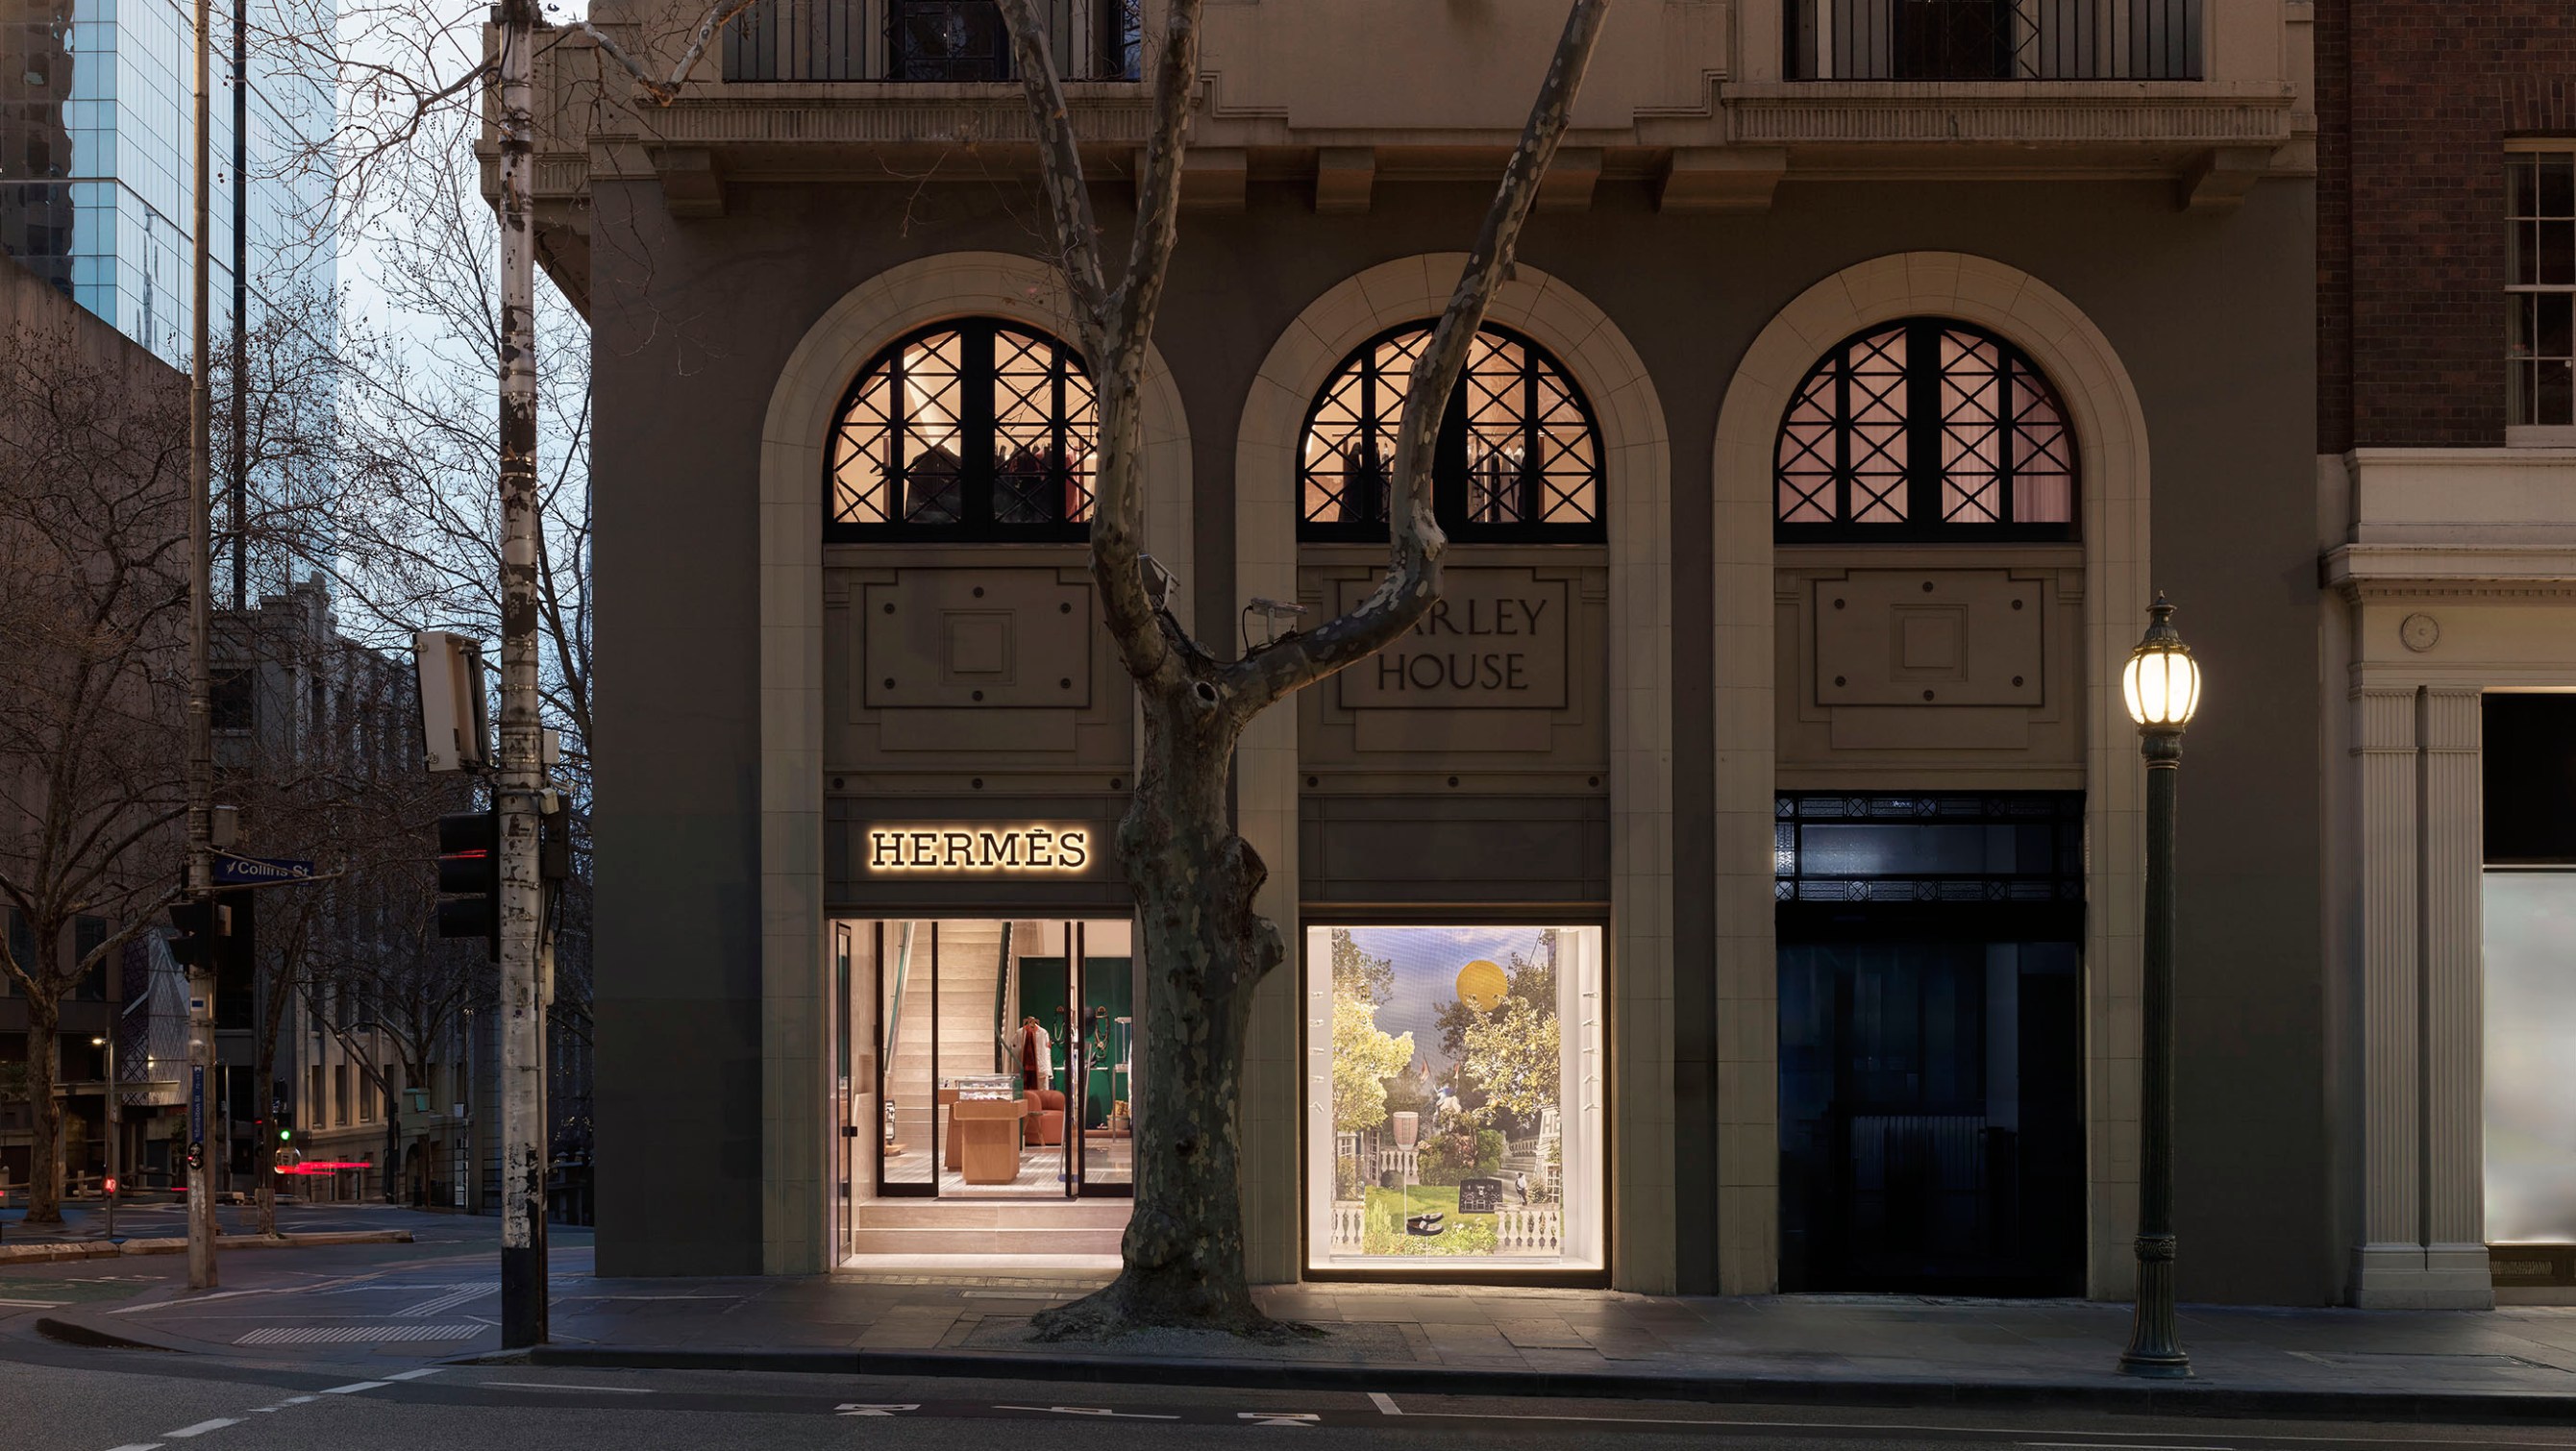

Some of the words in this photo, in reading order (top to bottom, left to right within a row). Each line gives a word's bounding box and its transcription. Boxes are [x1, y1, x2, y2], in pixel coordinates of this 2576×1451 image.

[1355, 599, 1547, 635] RLEY
[1377, 653, 1528, 690] HOUSE
[873, 828, 1086, 868] HERMÈS
[237, 860, 288, 876] Collins
[292, 864, 310, 877] St
